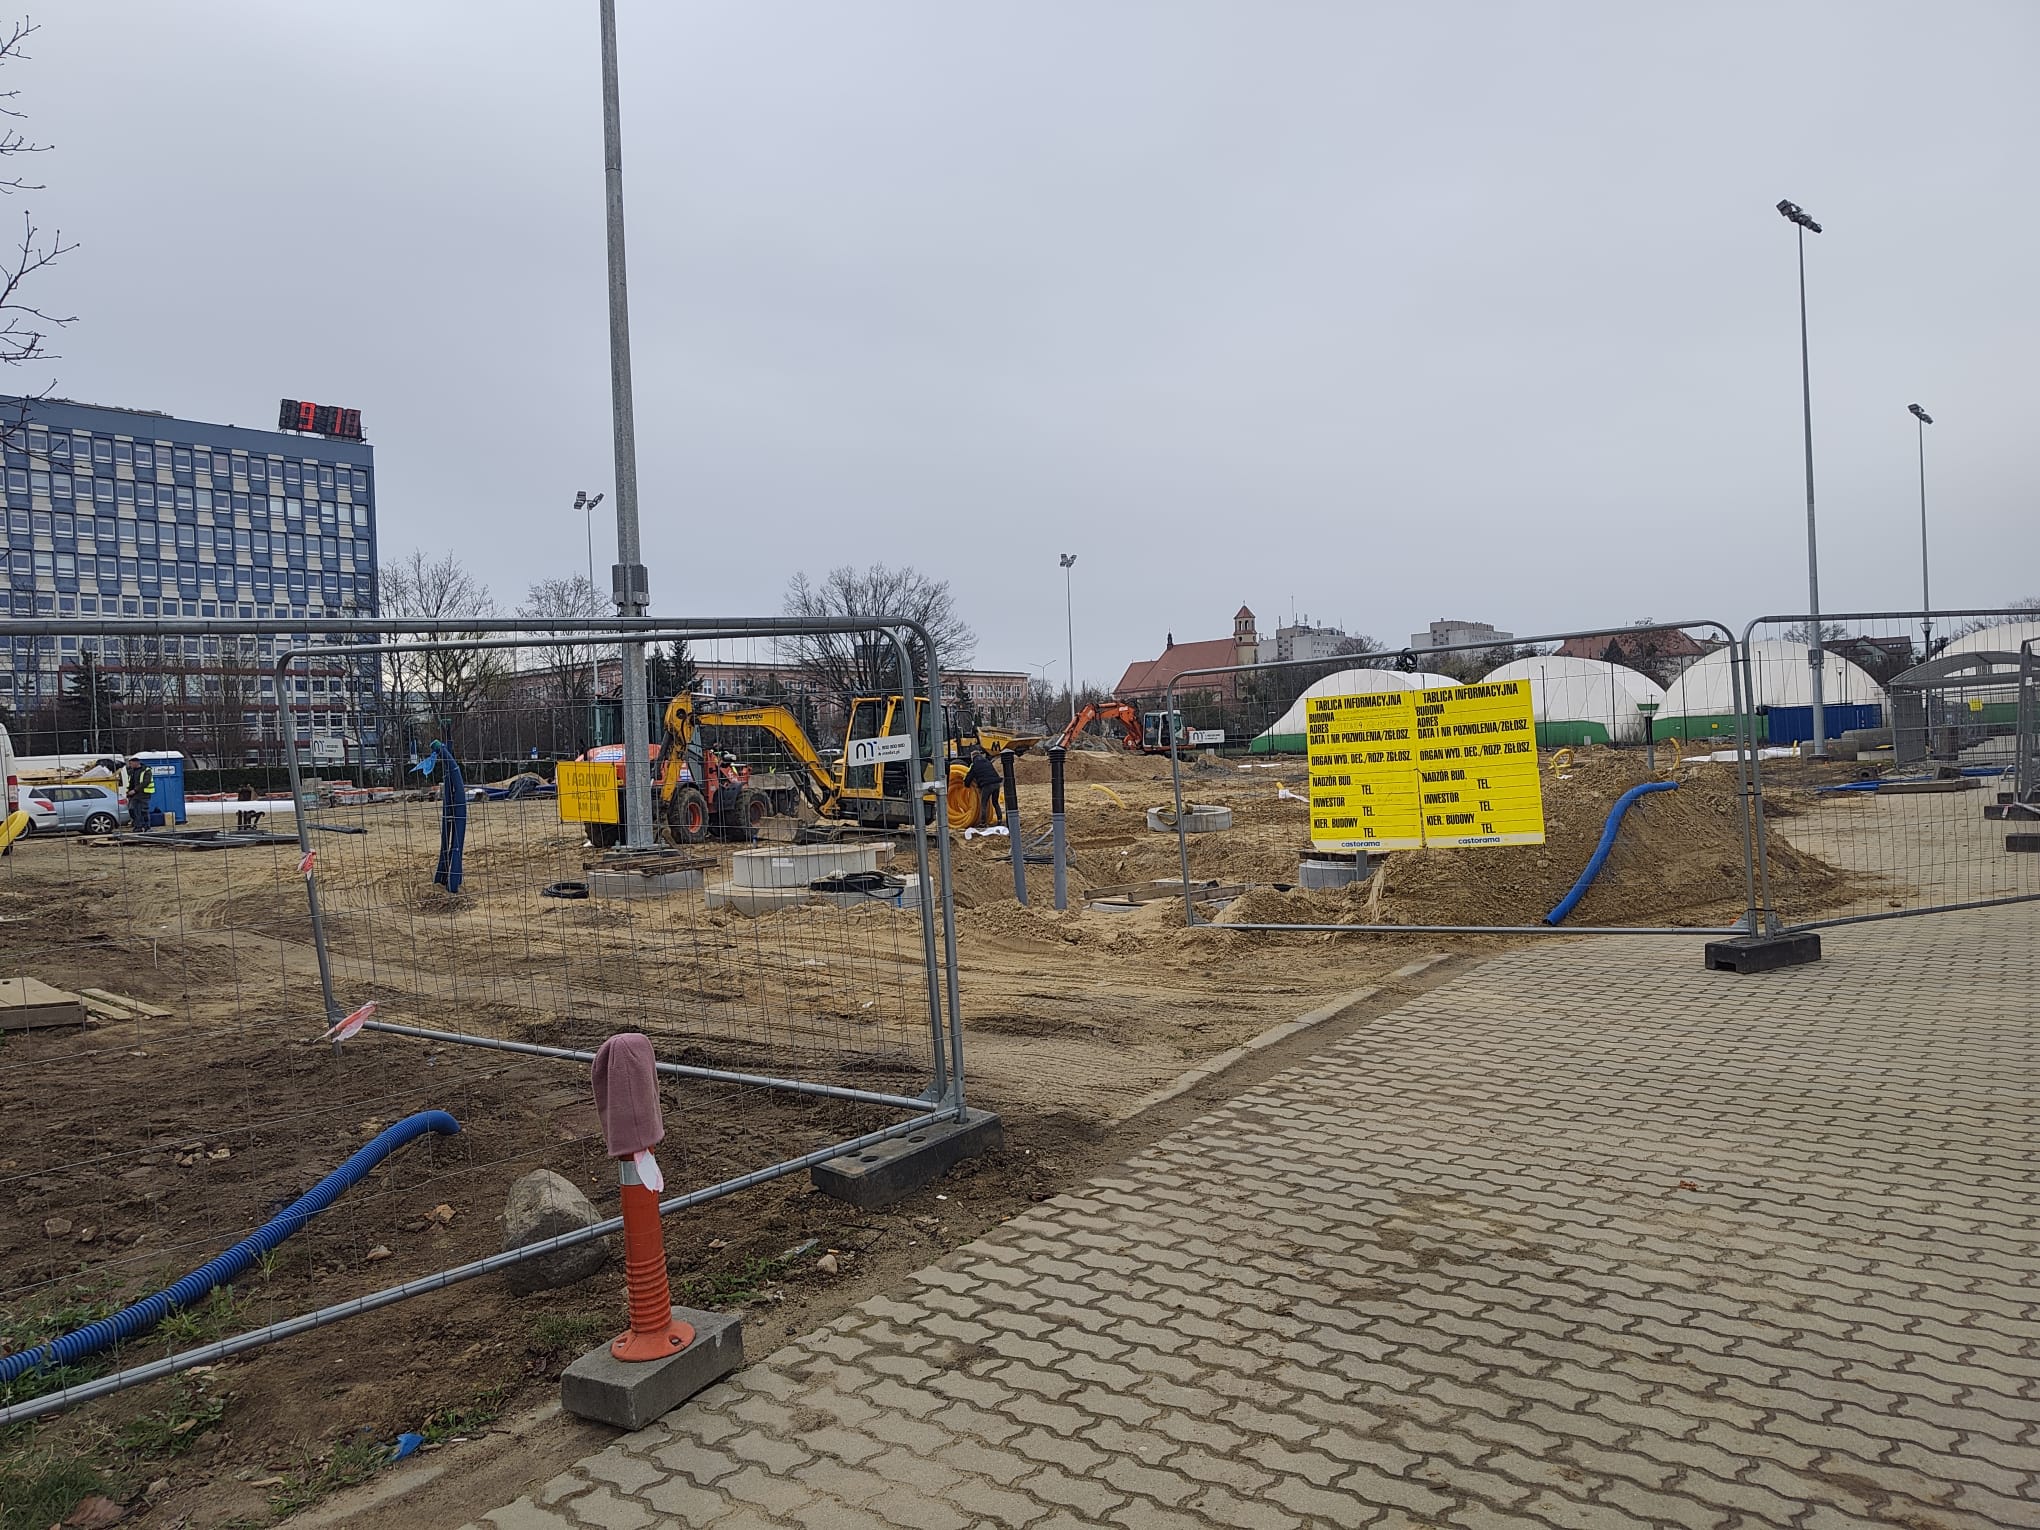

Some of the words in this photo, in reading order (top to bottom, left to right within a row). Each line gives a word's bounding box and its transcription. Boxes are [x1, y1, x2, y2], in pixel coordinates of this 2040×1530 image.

[1423, 689, 1453, 703] TABLICA
[1455, 683, 1518, 700] INFORMACYJNA
[1315, 699, 1342, 711] TABLICA
[1344, 694, 1401, 709] INFORMACYJNA
[1416, 704, 1445, 716] BUDOWA
[1309, 712, 1335, 723] BUDOWA
[1417, 716, 1438, 727] ADRES
[1310, 723, 1329, 734] ADRES
[1418, 728, 1435, 739] DATA
[1441, 726, 1452, 737] NR
[1310, 734, 1325, 745] DATA
[1331, 733, 1340, 744] NR
[1420, 748, 1444, 761] ORGAN
[1445, 747, 1463, 759] WYD.
[1504, 742, 1532, 754] ZGŁOSZ.
[1311, 755, 1332, 766] ORGAN
[1333, 754, 1349, 764] WYD.
[1386, 750, 1412, 762] ZGŁOSZ.
[1312, 775, 1337, 787] NADZÓR
[1422, 770, 1449, 782] NADZÓR
[1451, 770, 1467, 780] BUD.
[1477, 778, 1491, 789] TEL.
[1313, 797, 1345, 808] INWESTOR
[1424, 792, 1459, 804] INWESTOR
[1479, 801, 1494, 811] TEL.
[1332, 818, 1358, 828] BUDOWY
[1426, 815, 1444, 826] KIER.
[1446, 813, 1475, 825] BUDOWY
[1481, 823, 1496, 834] TEL.
[1341, 840, 1380, 848] castorama
[1458, 836, 1500, 845] castorama
